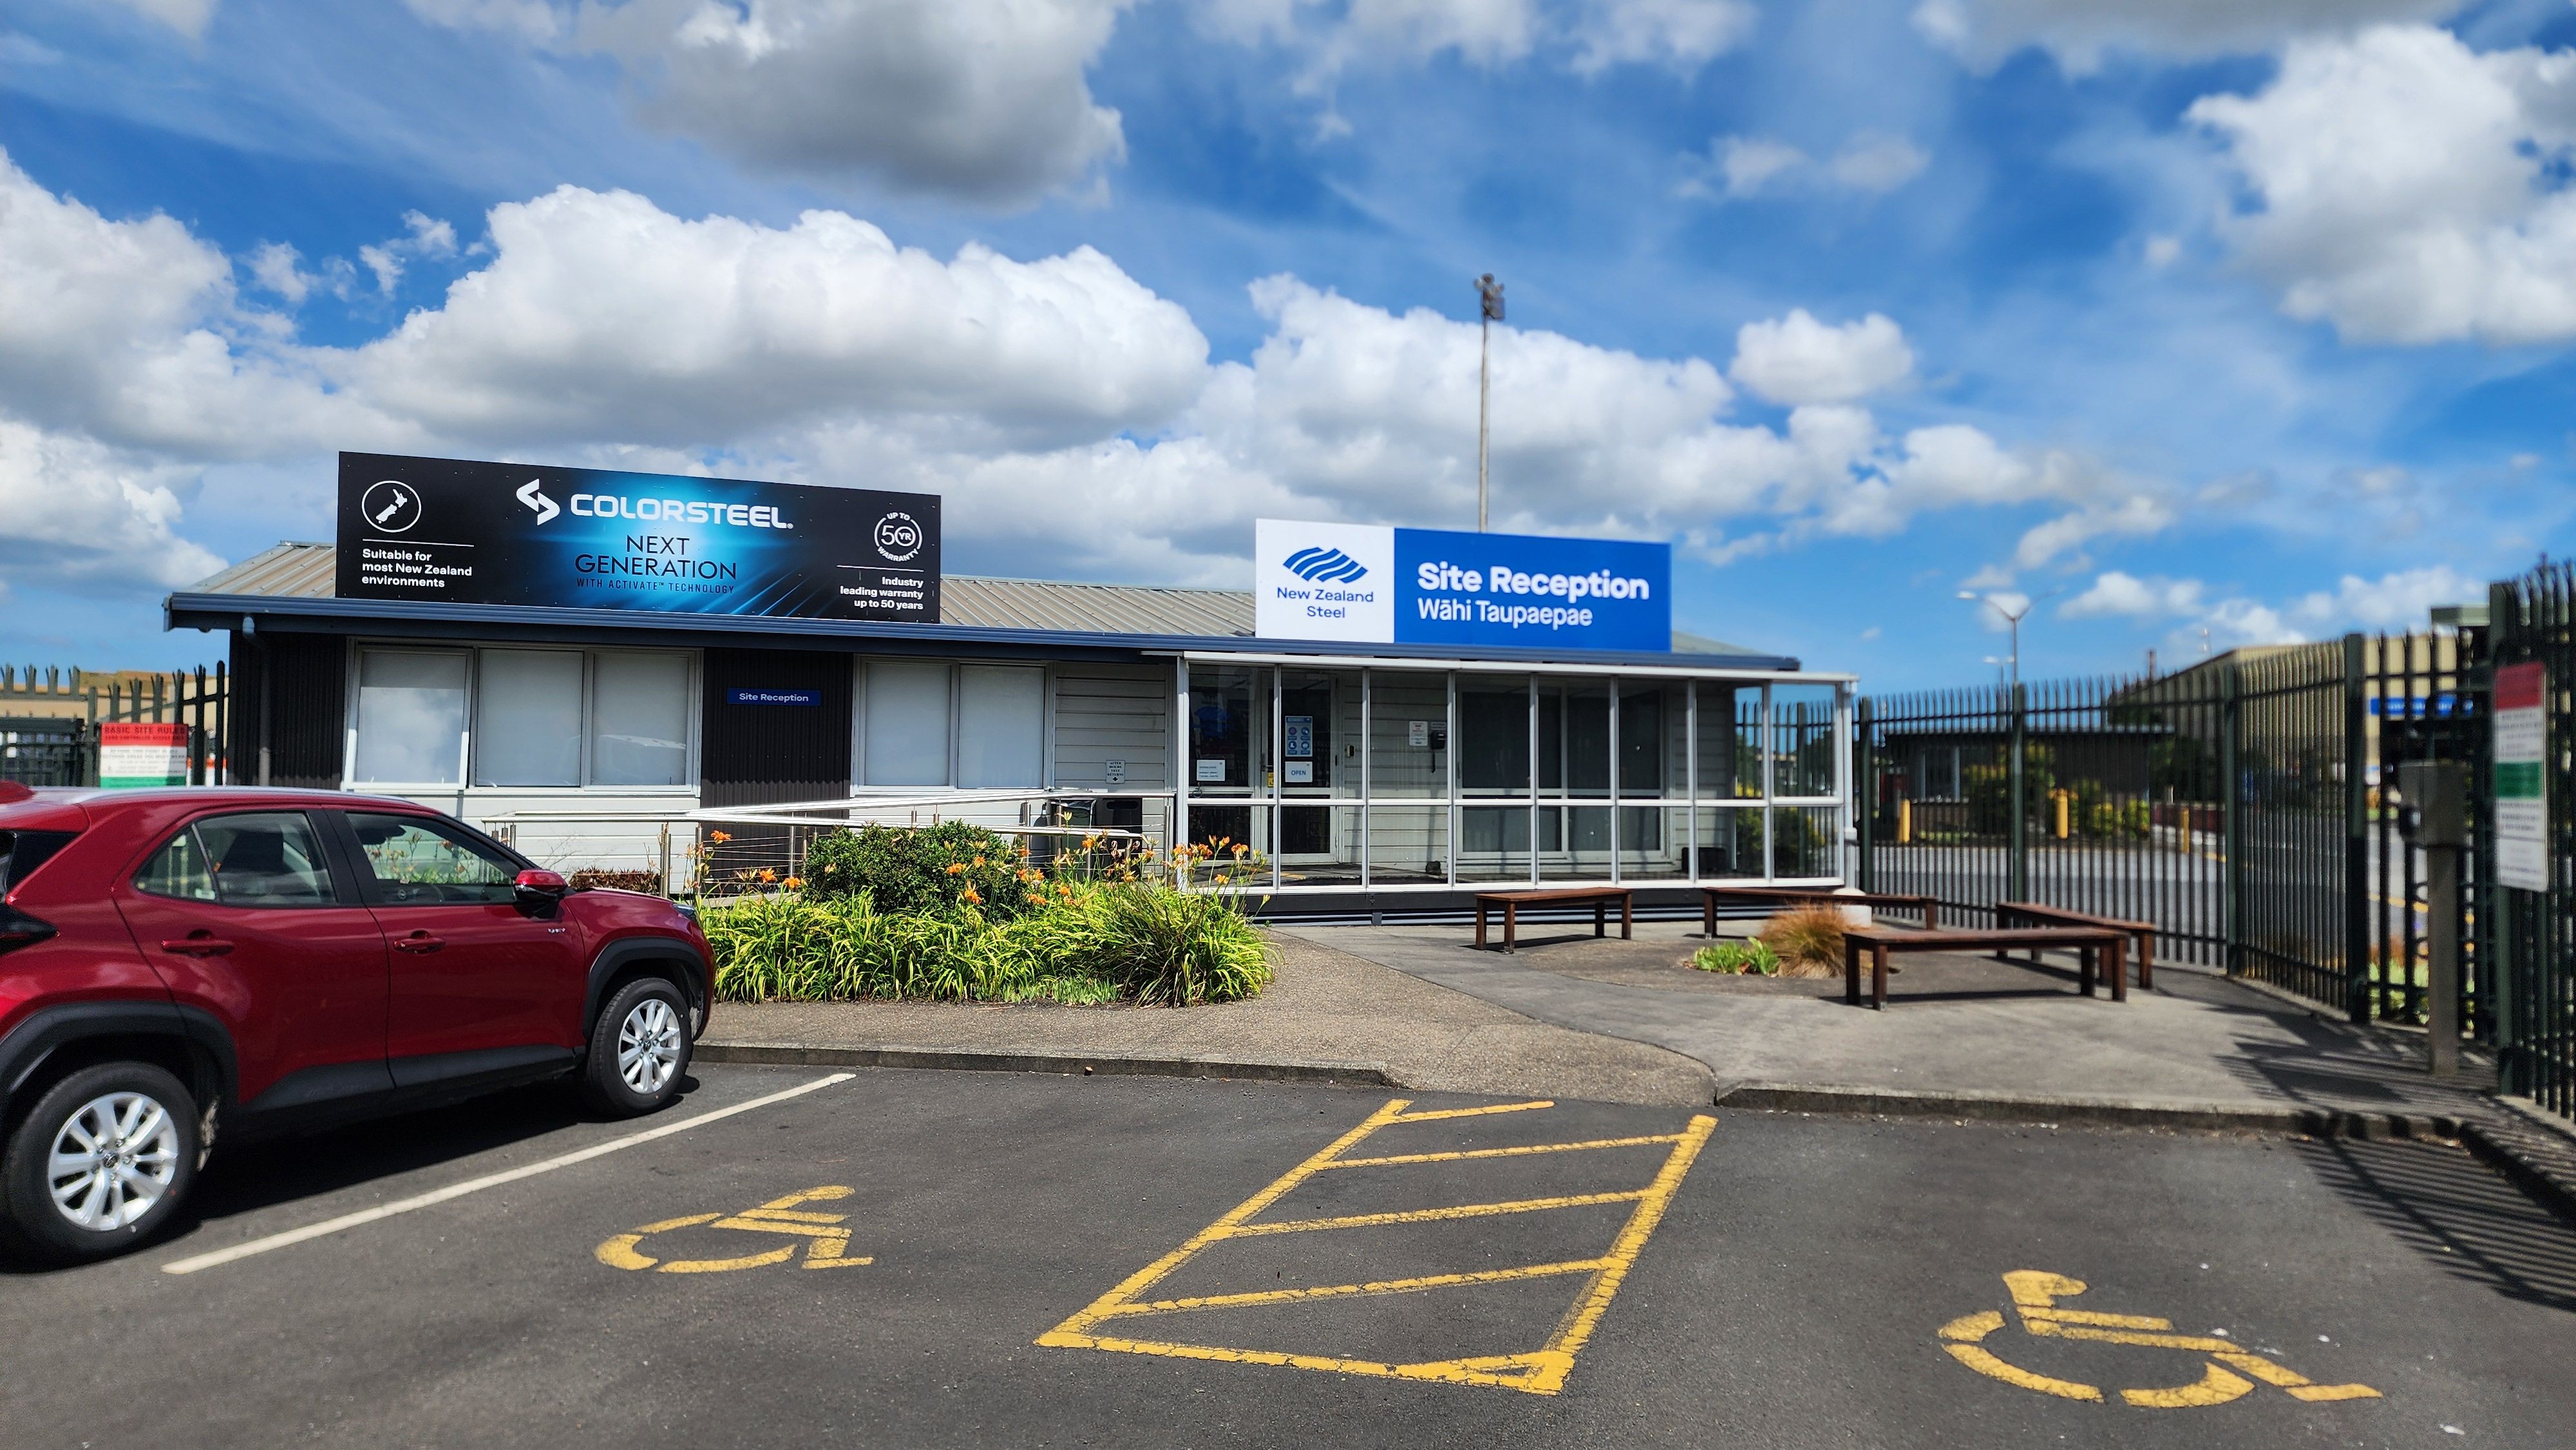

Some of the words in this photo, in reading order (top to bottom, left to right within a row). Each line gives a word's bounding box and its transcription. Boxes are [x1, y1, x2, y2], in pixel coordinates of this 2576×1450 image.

[899, 513, 911, 521] TO
[627, 534, 690, 555] NEXT
[363, 548, 413, 560] Suitable
[415, 551, 432, 561] for
[878, 546, 918, 561] WARRANTY
[362, 562, 393, 572] most
[395, 563, 422, 574] New
[424, 564, 472, 576] Zealand
[575, 554, 736, 580] GENERATION
[361, 575, 445, 587] environments
[577, 578, 603, 588] WITH
[668, 582, 734, 594] TECHNOLOGY
[882, 576, 924, 588] Industry
[1417, 561, 1482, 591] Site
[1490, 566, 1650, 604] Reception
[840, 585, 878, 598] leading
[879, 589, 924, 600] warranty
[1277, 587, 1311, 599] New
[1314, 588, 1374, 602] Zealand
[854, 599, 867, 608] up
[869, 599, 880, 608] to
[880, 599, 895, 608] 50
[896, 601, 923, 610] years
[1307, 605, 1345, 618] Steel
[1417, 597, 1472, 621] Wāhi
[1475, 599, 1593, 631] Taupaepae
[739, 692, 759, 701] Site
[760, 693, 809, 703] Reception
